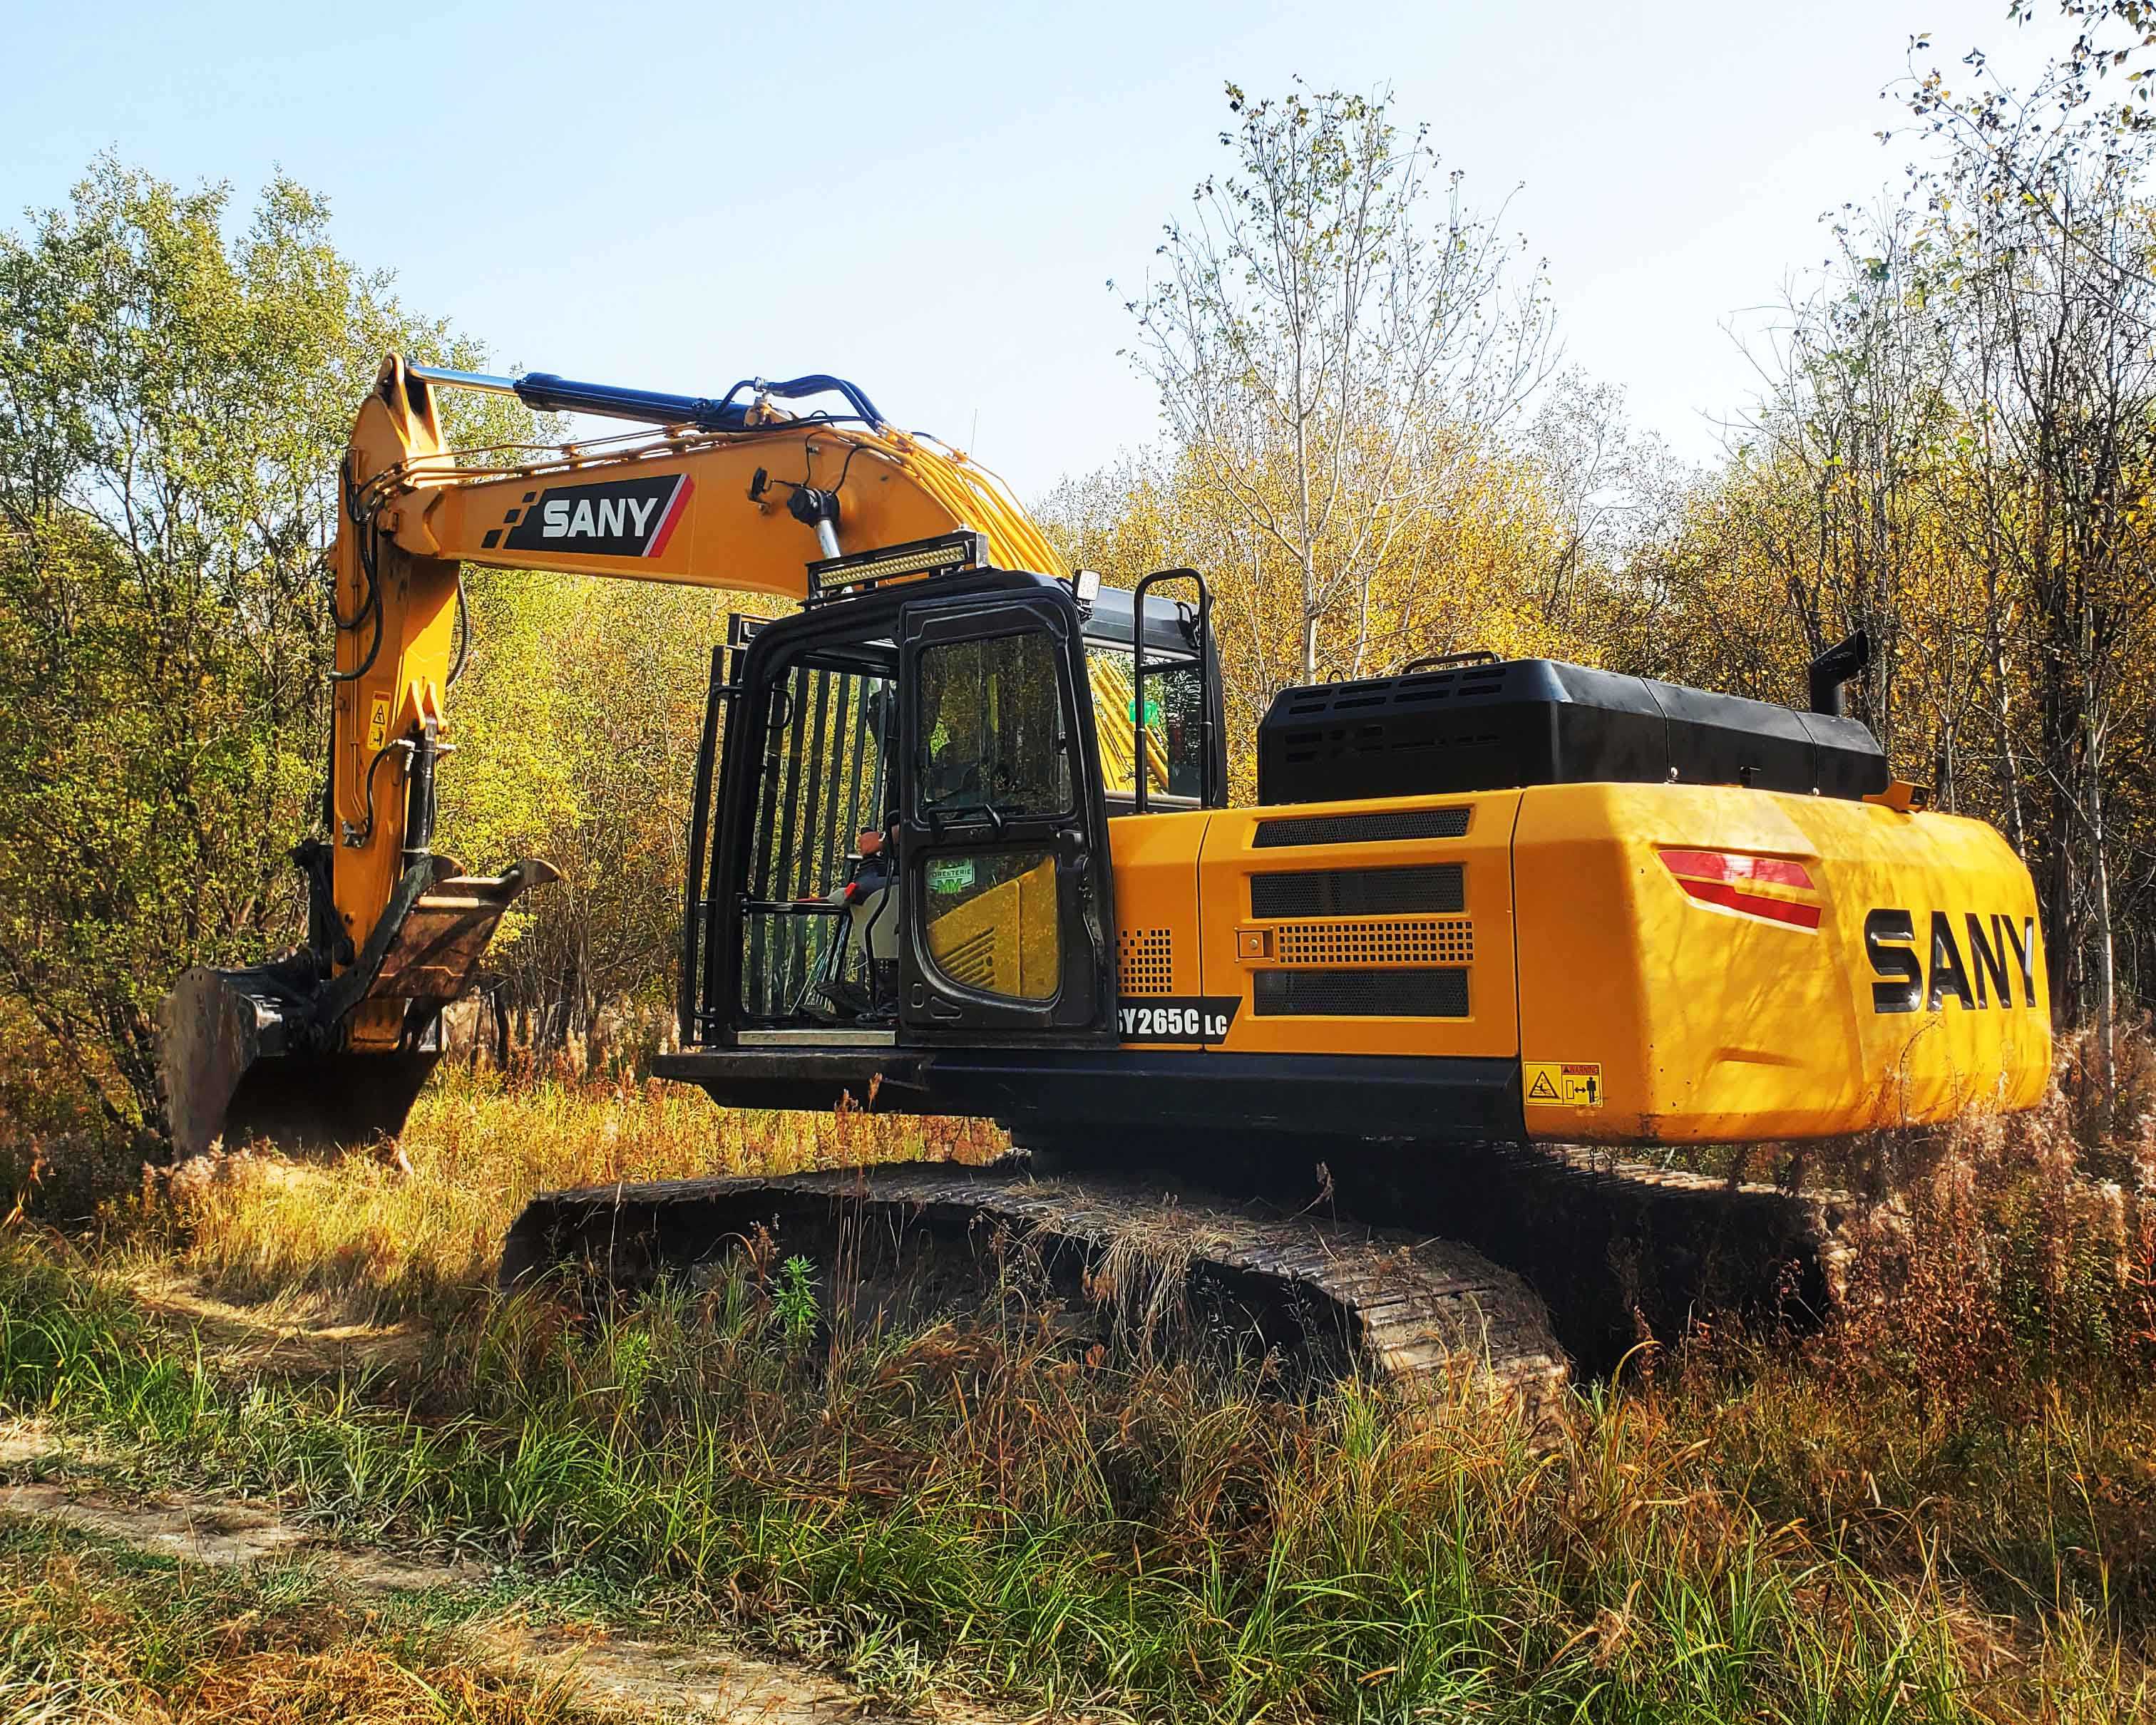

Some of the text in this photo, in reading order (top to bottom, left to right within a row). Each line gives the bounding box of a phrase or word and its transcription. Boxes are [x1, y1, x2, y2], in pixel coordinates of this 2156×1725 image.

[543, 498, 658, 538] SANY
[1863, 907, 2036, 1014] SANY
[1205, 1014, 1227, 1035] LC
